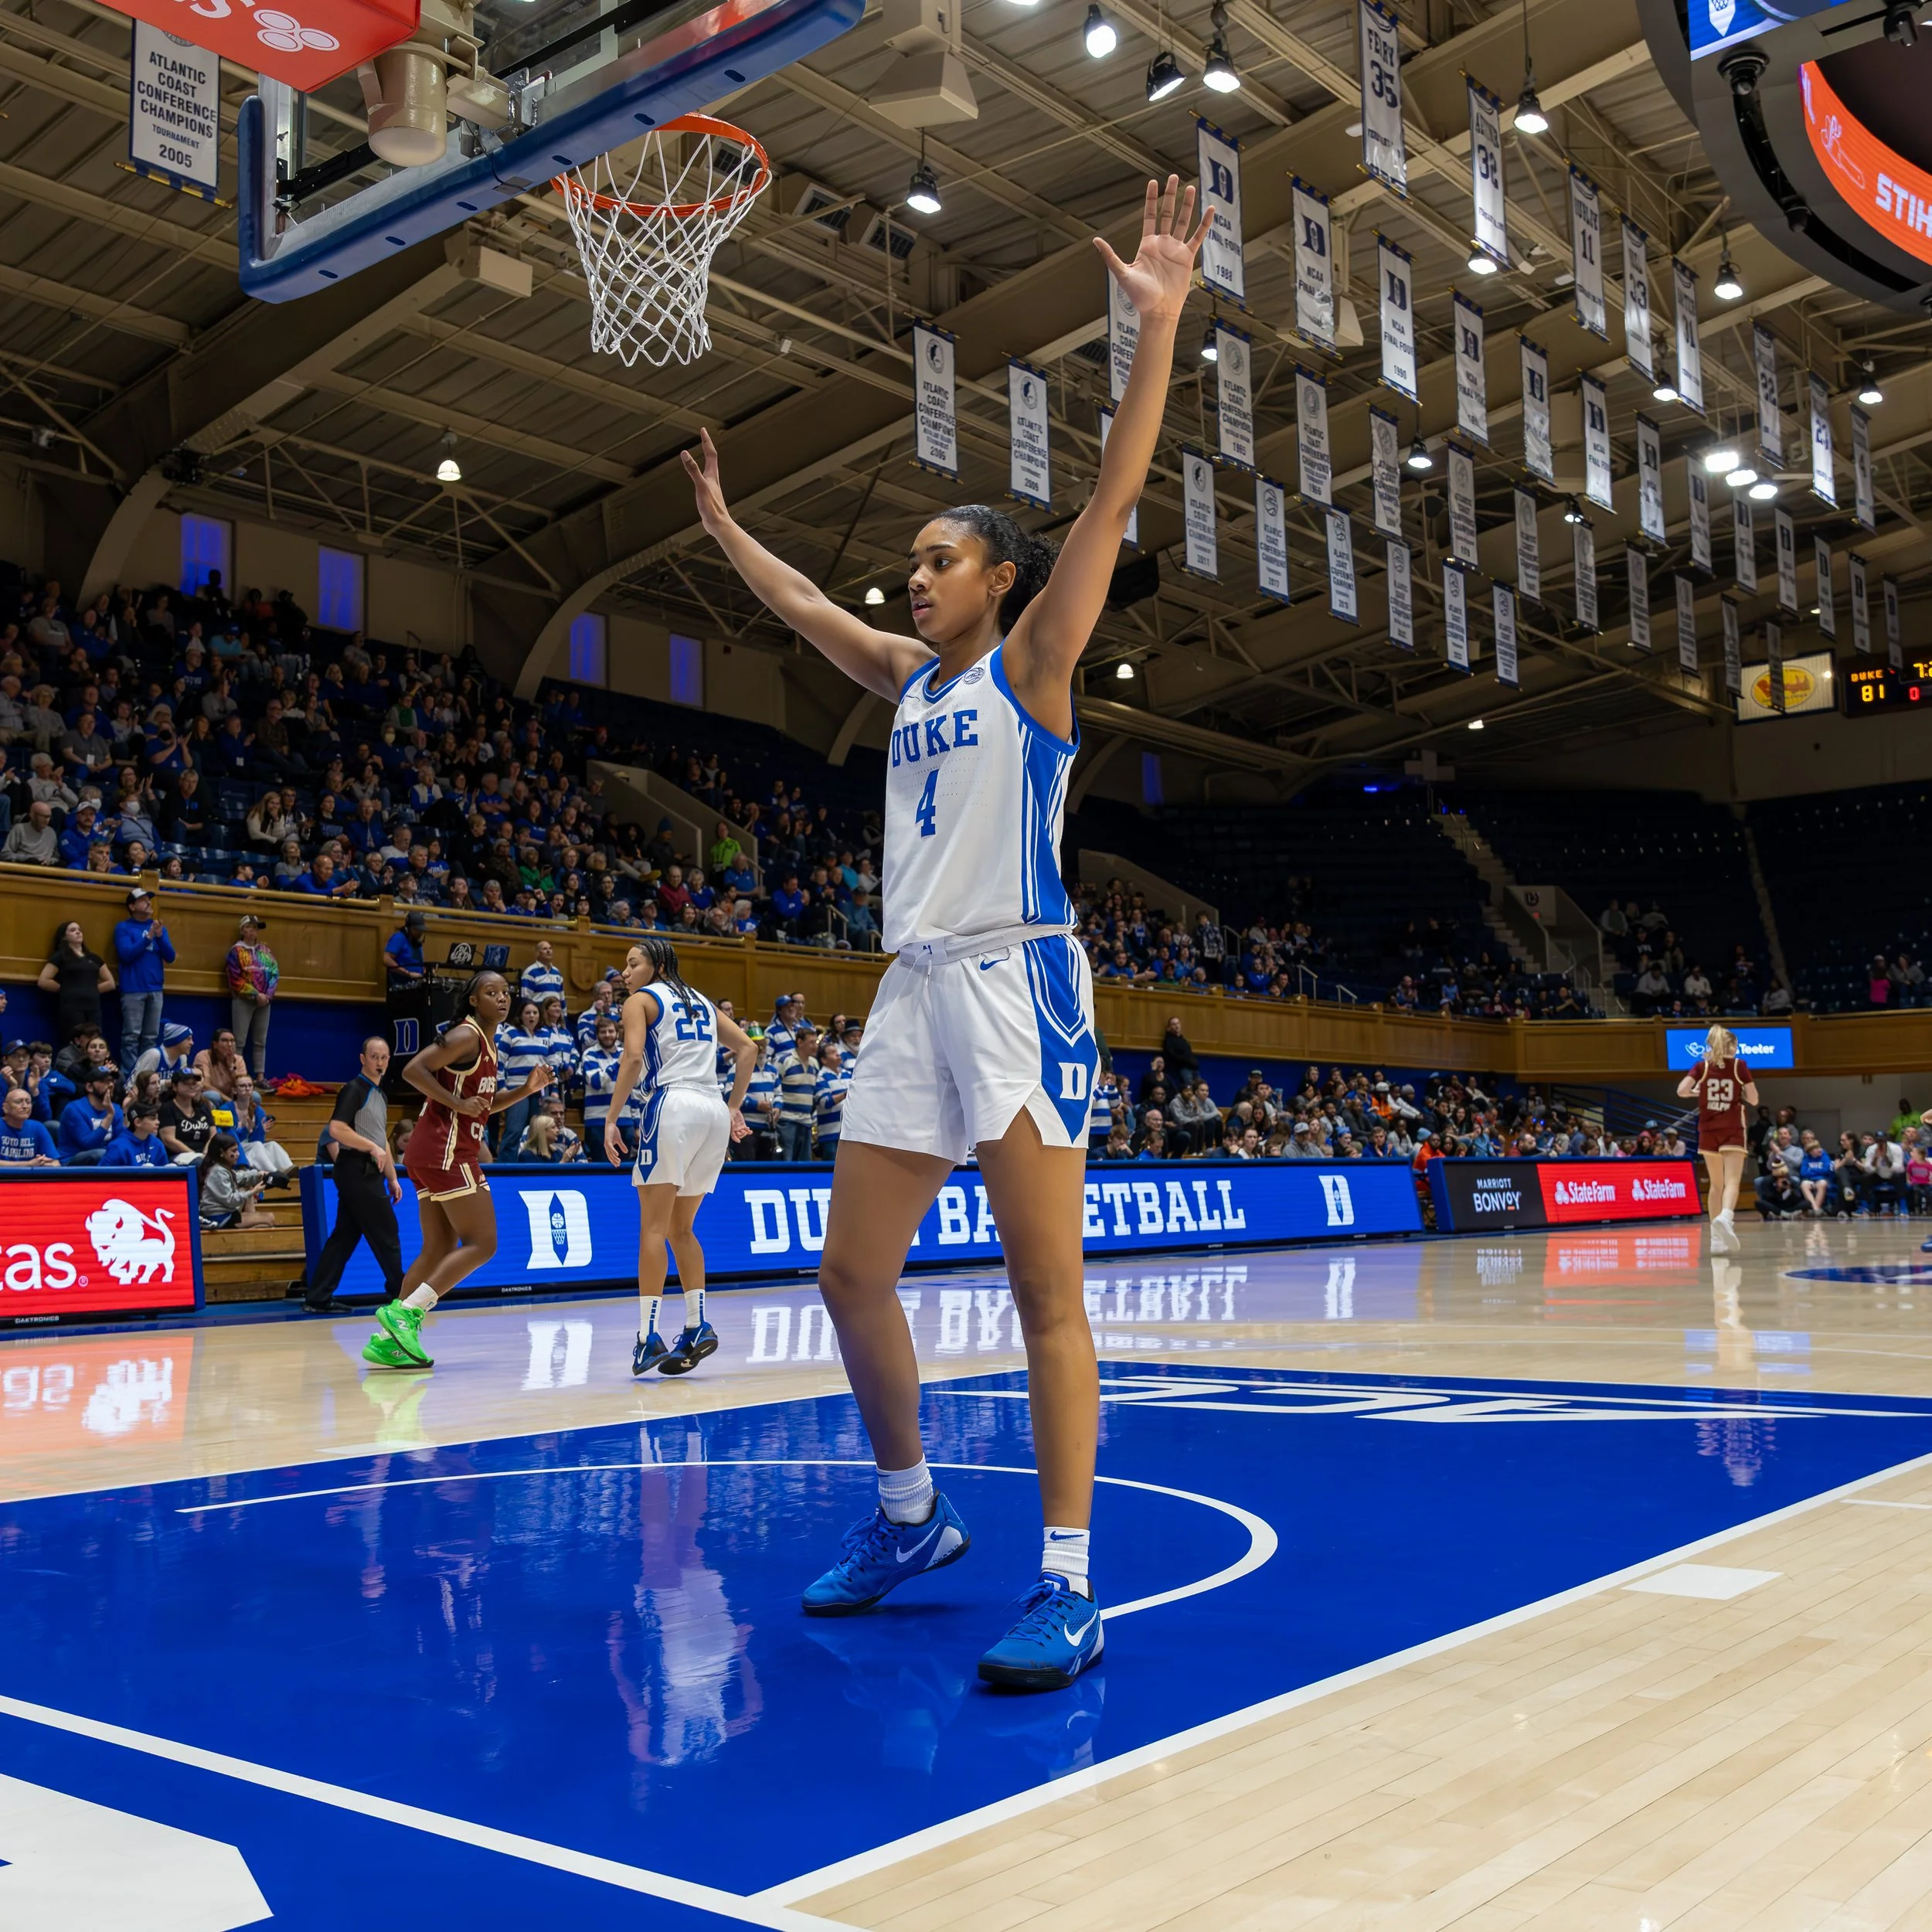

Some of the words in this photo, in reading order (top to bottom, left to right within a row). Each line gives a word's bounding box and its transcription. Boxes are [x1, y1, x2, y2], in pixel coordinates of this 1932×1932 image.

[150, 51, 206, 85] ATLANTIC
[158, 72, 197, 98] COAST
[1371, 60, 1398, 109] 35
[137, 80, 217, 124] CONFERENCE
[141, 99, 213, 138] CHAMPIONS
[151, 124, 200, 150] TOURNAMENT
[159, 144, 192, 168] 2005
[1214, 213, 1233, 232] NCAA
[1307, 266, 1325, 284] NCAA
[923, 380, 950, 401] ATLANTIC
[927, 394, 947, 411] COAST
[918, 402, 956, 427] CONFERENCE
[1016, 415, 1044, 435] ATLANTIC
[920, 415, 955, 438] CHAMPIONS
[1022, 428, 1040, 446] COAST
[1012, 437, 1048, 461] CONFERENCE
[1850, 668, 1885, 683] DUKE
[1860, 683, 1886, 702] 81
[892, 709, 979, 769] DUKE
[915, 768, 940, 838] 4
[671, 1002, 713, 1043] 22
[1741, 1043, 1775, 1055] Teeter
[1058, 1062, 1088, 1101] D
[1706, 1078, 1734, 1102] 23
[181, 1118, 209, 1133] Duke
[640, 1148, 653, 1166] D
[1476, 1178, 1512, 1190] MARRIOTT
[936, 1179, 1247, 1246] BAETBALL
[1473, 1192, 1521, 1213] BONVOY
[0, 1242, 77, 1291] as
[501, 1285, 532, 1294] DAKTRONICS
[15, 1315, 60, 1325] DAKTRONICS
